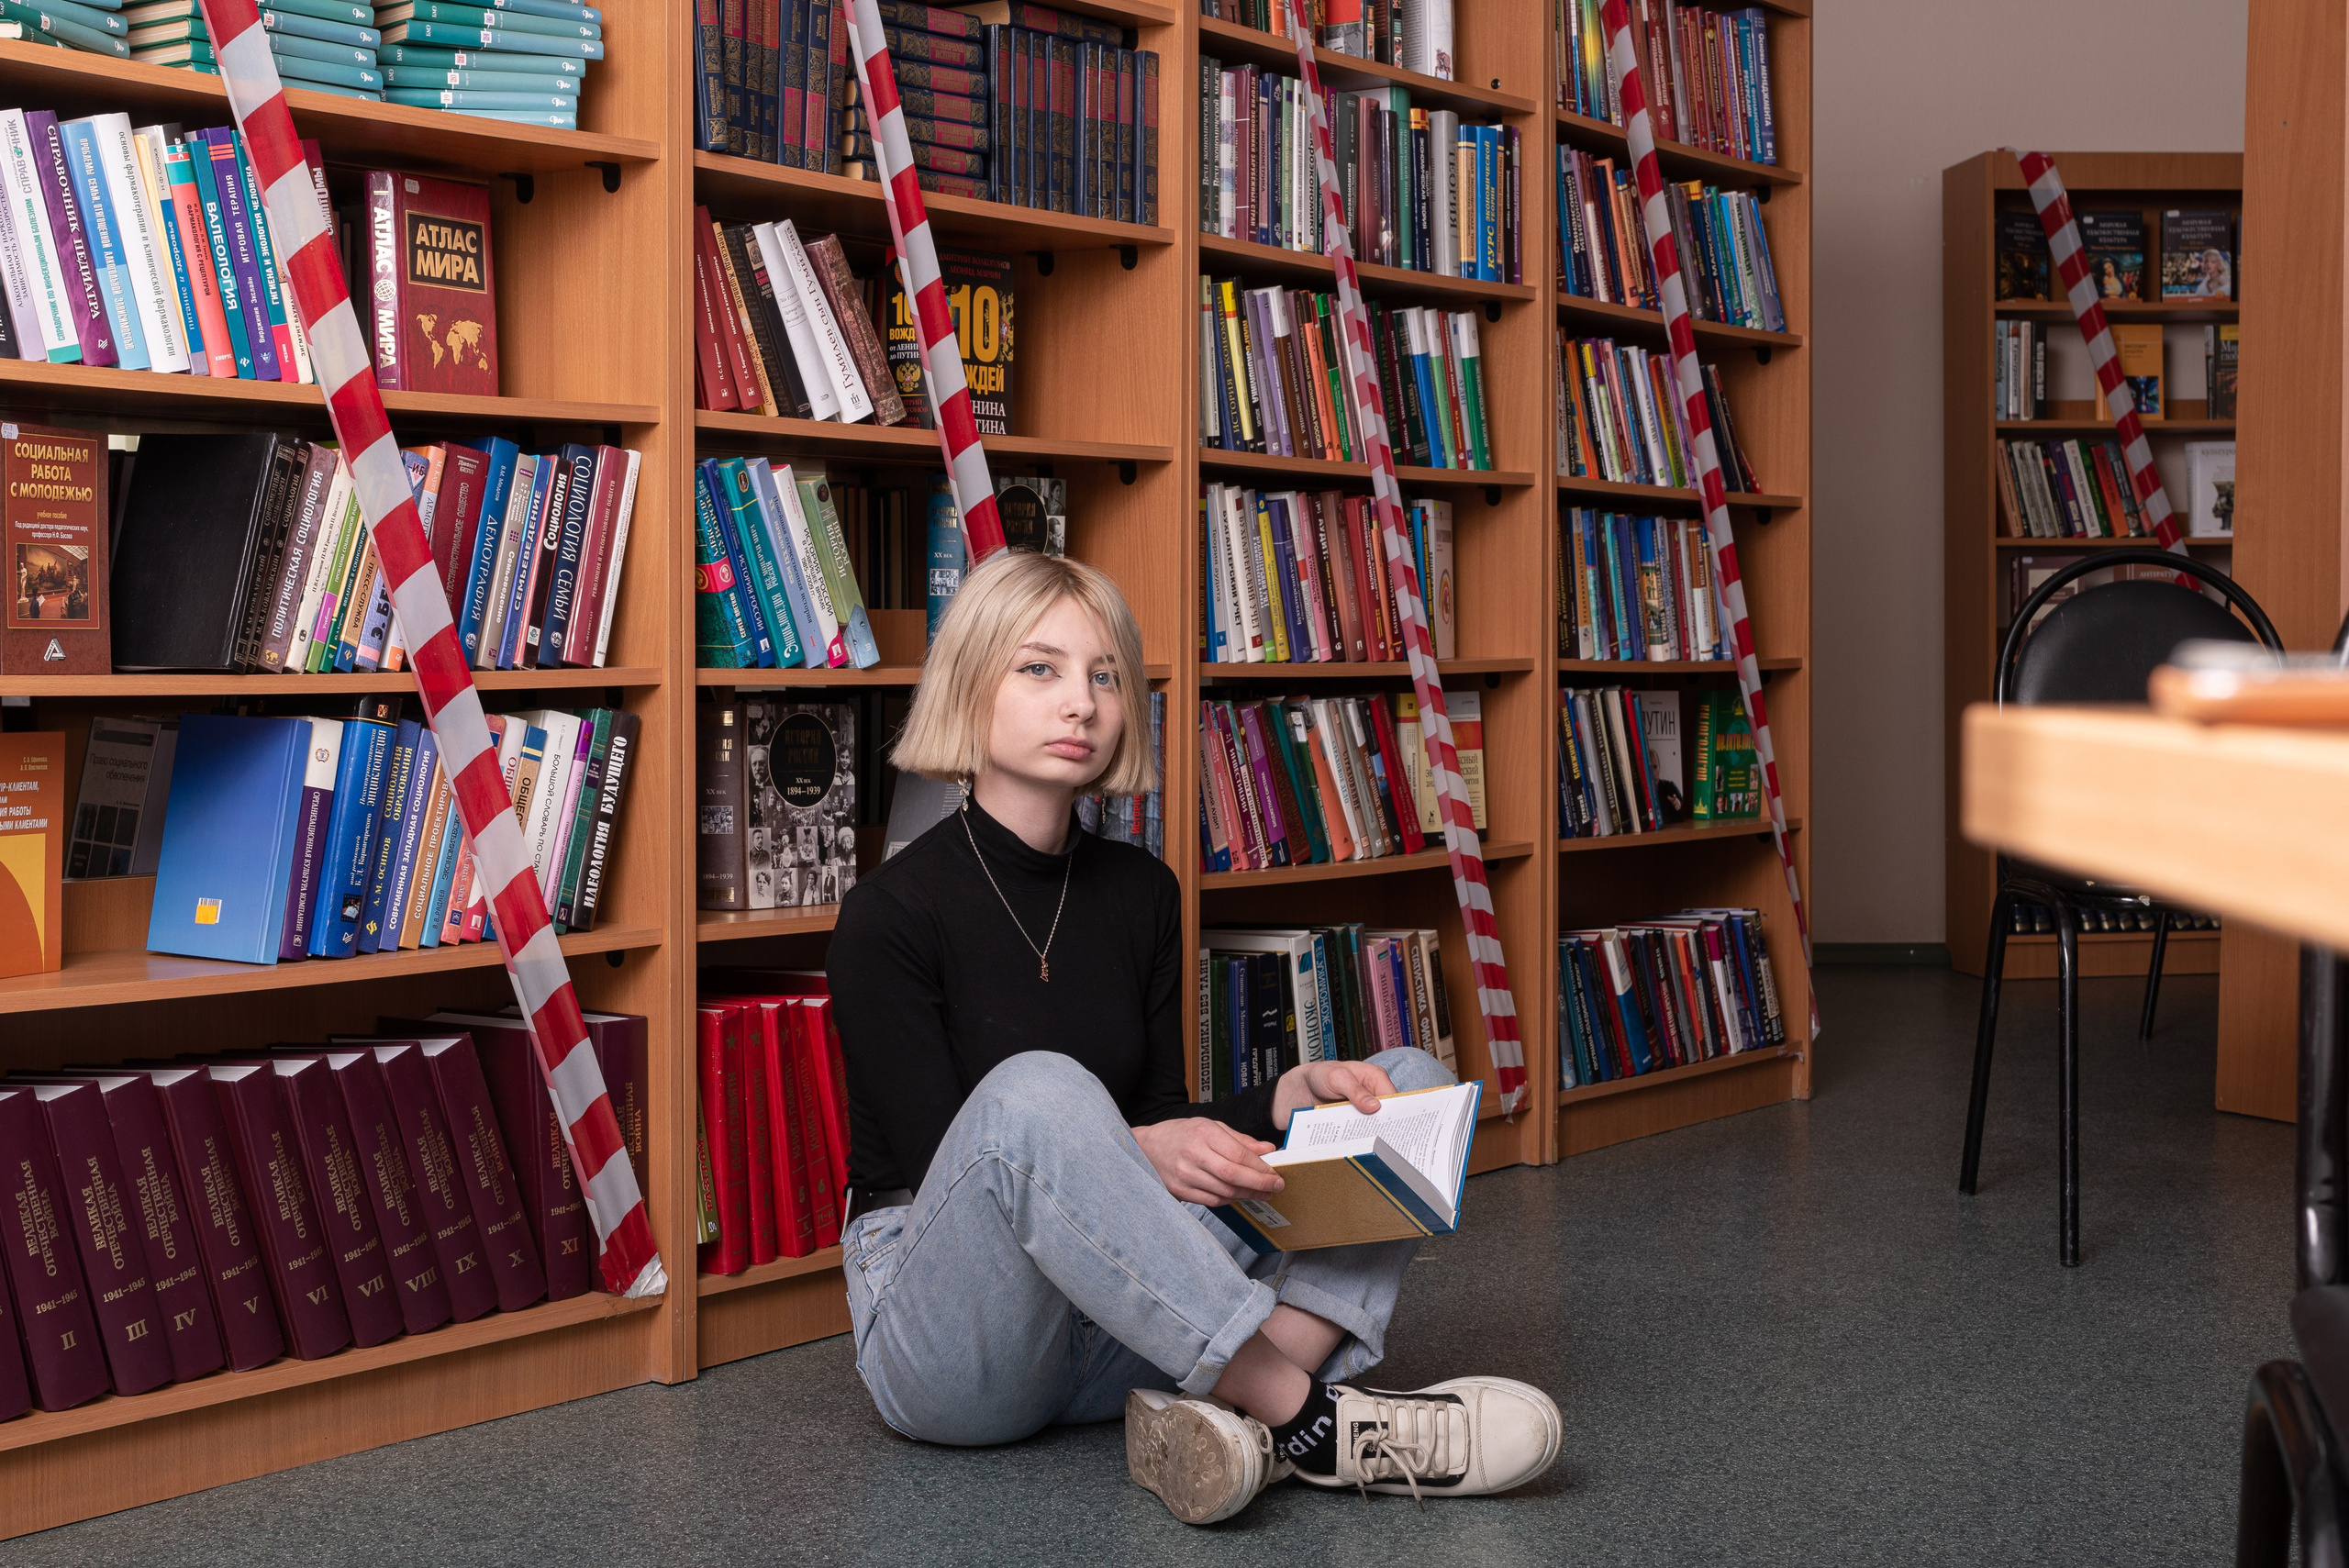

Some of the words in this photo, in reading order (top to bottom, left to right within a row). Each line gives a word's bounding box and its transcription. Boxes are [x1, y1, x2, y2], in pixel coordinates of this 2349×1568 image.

[48, 125, 80, 233] СПРАВОЧНИК
[73, 238, 100, 319] ПЕДИАТРА
[124, 164, 147, 233] фармакотерапии
[225, 174, 239, 216] ТЕРАПИЯ
[80, 138, 95, 175] ПРОБЛЕМЫ
[105, 251, 123, 295] АЛКОГОЛЬНОЙ
[115, 298, 135, 350] ЗАВИСИМОСТЬЮ
[206, 202, 238, 310] ВАЛЕОЛОГИЯ
[235, 221, 250, 263] ИГРОВАЯ
[256, 212, 271, 257] ЭКОЛОГИЯ
[373, 206, 392, 273] АТЛАС
[416, 222, 477, 254] АТЛАС
[144, 244, 163, 295] клинической
[266, 267, 279, 306] ГИГИЕНА
[416, 250, 480, 284] МИРА
[153, 298, 175, 356] фармакологии
[253, 306, 265, 343] Вирджиния
[377, 309, 396, 369] МИРА
[951, 284, 999, 362] 10
[1216, 296, 1229, 373] ЭКОНОМИКИ
[964, 364, 1004, 395] ЖДЕЙ
[1226, 378, 1239, 433] ИСТОРИЯ
[15, 442, 88, 462] СОЦИАЛЬНАЯ
[31, 464, 72, 481] РАБОТА
[10, 482, 17, 497] С
[20, 483, 92, 502] МОЛОДЕЖЬЮ
[543, 473, 567, 550] Социология
[562, 455, 592, 562] СОЦИОЛОГИЯ
[272, 547, 303, 638] ПОЛИТИЧЕСКАЯ
[296, 471, 324, 545] СОЦИОЛОГИЯ
[514, 491, 541, 611] СЕМЬЕВЕДЕНИЕ
[699, 500, 718, 557] АЛЕКСАНДР
[707, 495, 726, 555] СУВОРОВ
[827, 524, 847, 578] ИСТОРИЯ
[353, 562, 374, 628] ПРЕСС-СЛУЖБА
[471, 515, 497, 621] ДЕМОГРАФИЯ
[496, 550, 515, 623] Семьеведение
[553, 569, 573, 620] СЕМЬИ
[739, 554, 753, 594] ИСТОРИЯ
[750, 596, 763, 631] РОССИИ
[804, 528, 821, 577] ИСТОРИЯ
[818, 578, 833, 617] РОССИИ
[367, 729, 387, 806] ЭНЦИКЛОПЕДИЯ
[384, 746, 403, 817] СОЦИОЛОГИЯ
[394, 748, 412, 820] ОБРАЗОВАНИЯ
[9, 806, 31, 816] РАБОТЫ
[389, 865, 408, 929] СОВРЕМЕННАЯ
[403, 815, 418, 862] ЗАПАДНАЯ
[413, 751, 430, 812] СОЦИОЛОГИЯ
[584, 821, 610, 908] ИДЕОЛОГИЯ
[601, 736, 627, 815] БУДУЩЕГО
[301, 860, 311, 892] КУЛЬТУРА
[378, 838, 391, 880] ОСИПОВ
[108, 1182, 127, 1233] ВОЙНА
[697, 1139, 713, 1212] РАЗГРОМ
[16, 1192, 39, 1256] ВЕЛИКАЯ
[20, 1160, 57, 1277] ОТЕЧЕСТВЕННАЯ
[41, 1187, 59, 1239] ВОЙНА
[82, 1186, 106, 1251] ВЕЛИКАЯ
[87, 1155, 125, 1271] ОТЕЧЕСТВЕННАЯ
[138, 1176, 159, 1240] ВЕЛИКАЯ
